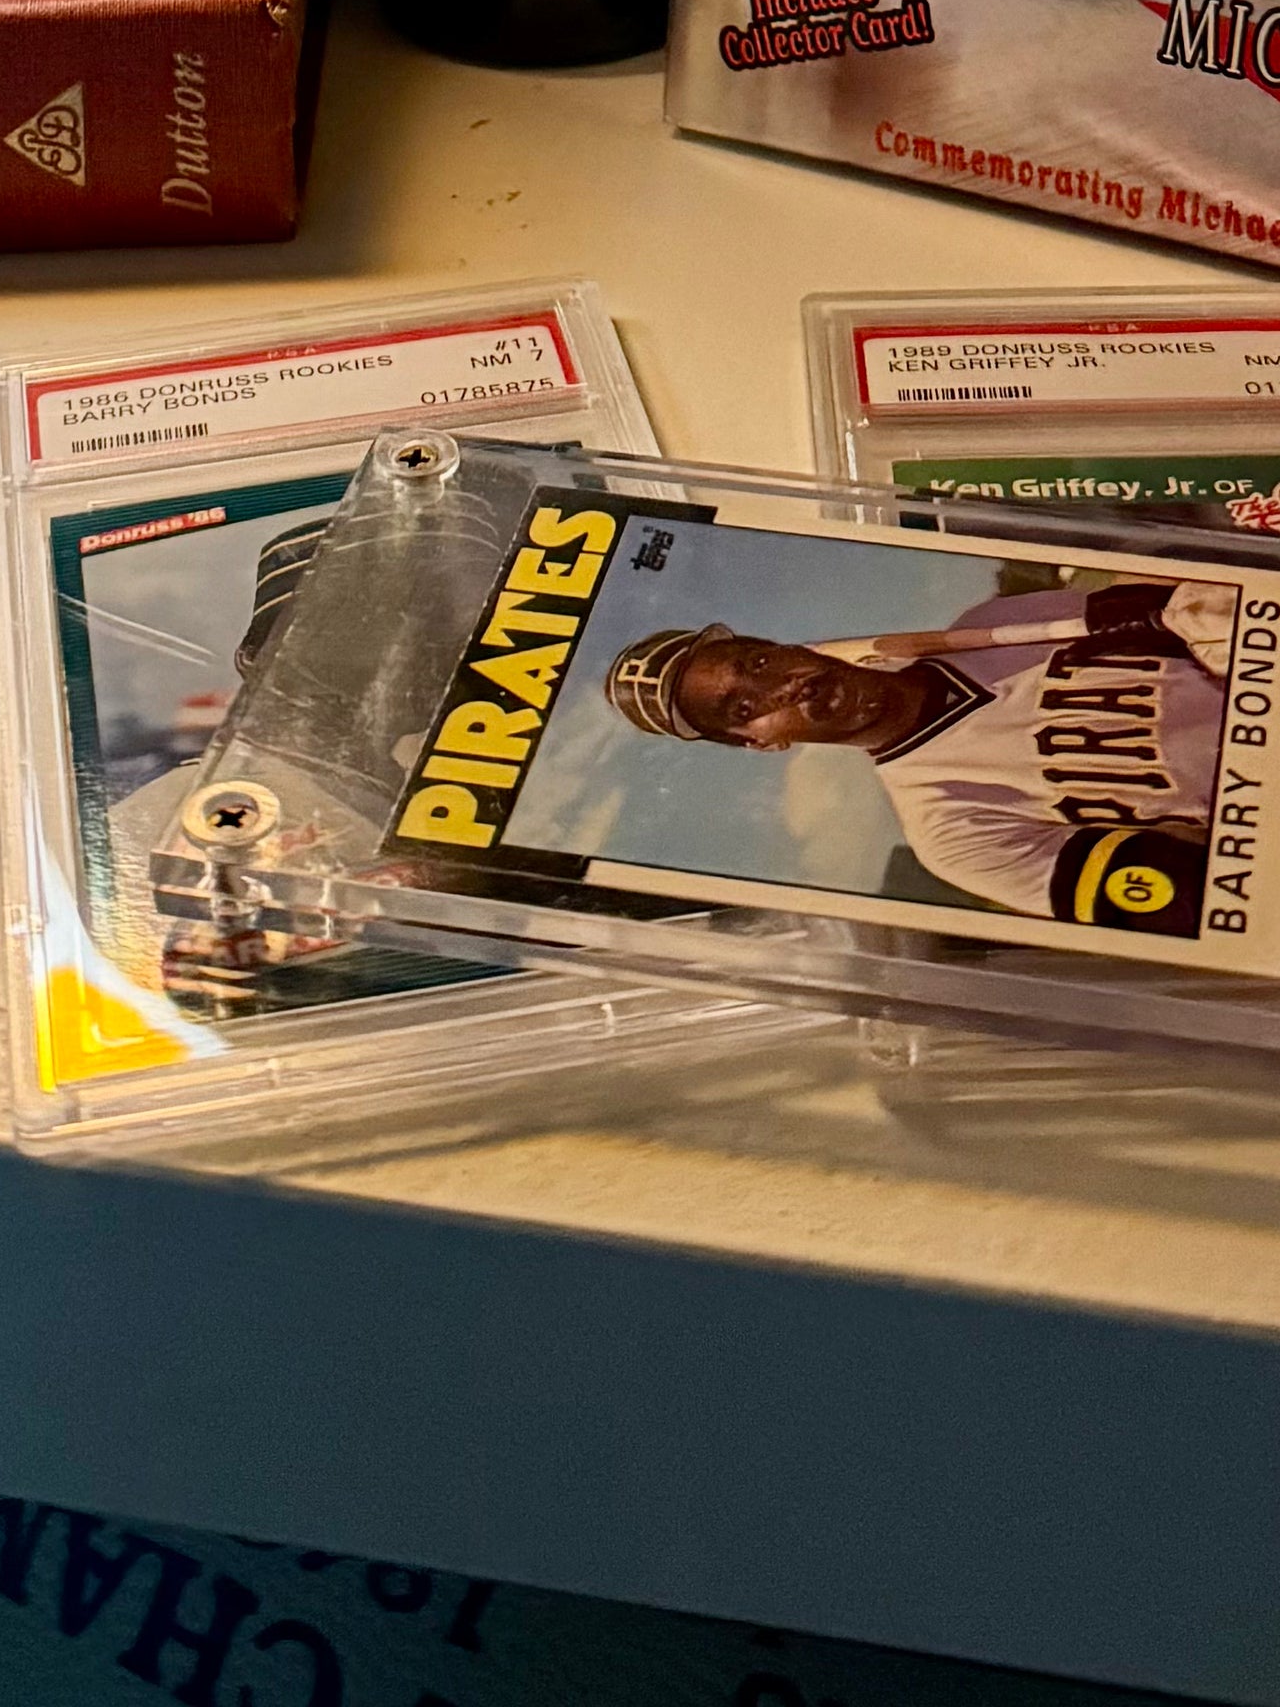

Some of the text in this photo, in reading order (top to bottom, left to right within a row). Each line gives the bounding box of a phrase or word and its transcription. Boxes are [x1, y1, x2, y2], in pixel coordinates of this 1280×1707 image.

[722, 21, 845, 68] Collector
[161, 50, 214, 219] Dutton
[873, 119, 1146, 221] Commemorating
[470, 348, 544, 369] NM 7
[888, 341, 1217, 359] 1989 DONRUSS ROOKIES
[888, 355, 1107, 373] KEN GRIFFEY JR.
[63, 354, 394, 412] 1986 DONRUSS ROOKIES
[420, 377, 555, 405] 01785875
[62, 387, 257, 427] BARRY BONDS
[930, 478, 1005, 498] Ken
[1163, 476, 1207, 496] Jr.
[1213, 478, 1254, 495] OF
[1228, 496, 1280, 515] The
[79, 514, 185, 554] Donruss
[396, 506, 617, 849] PIRATES
[1207, 769, 1264, 935] BARRY
[1124, 872, 1157, 904] OF
